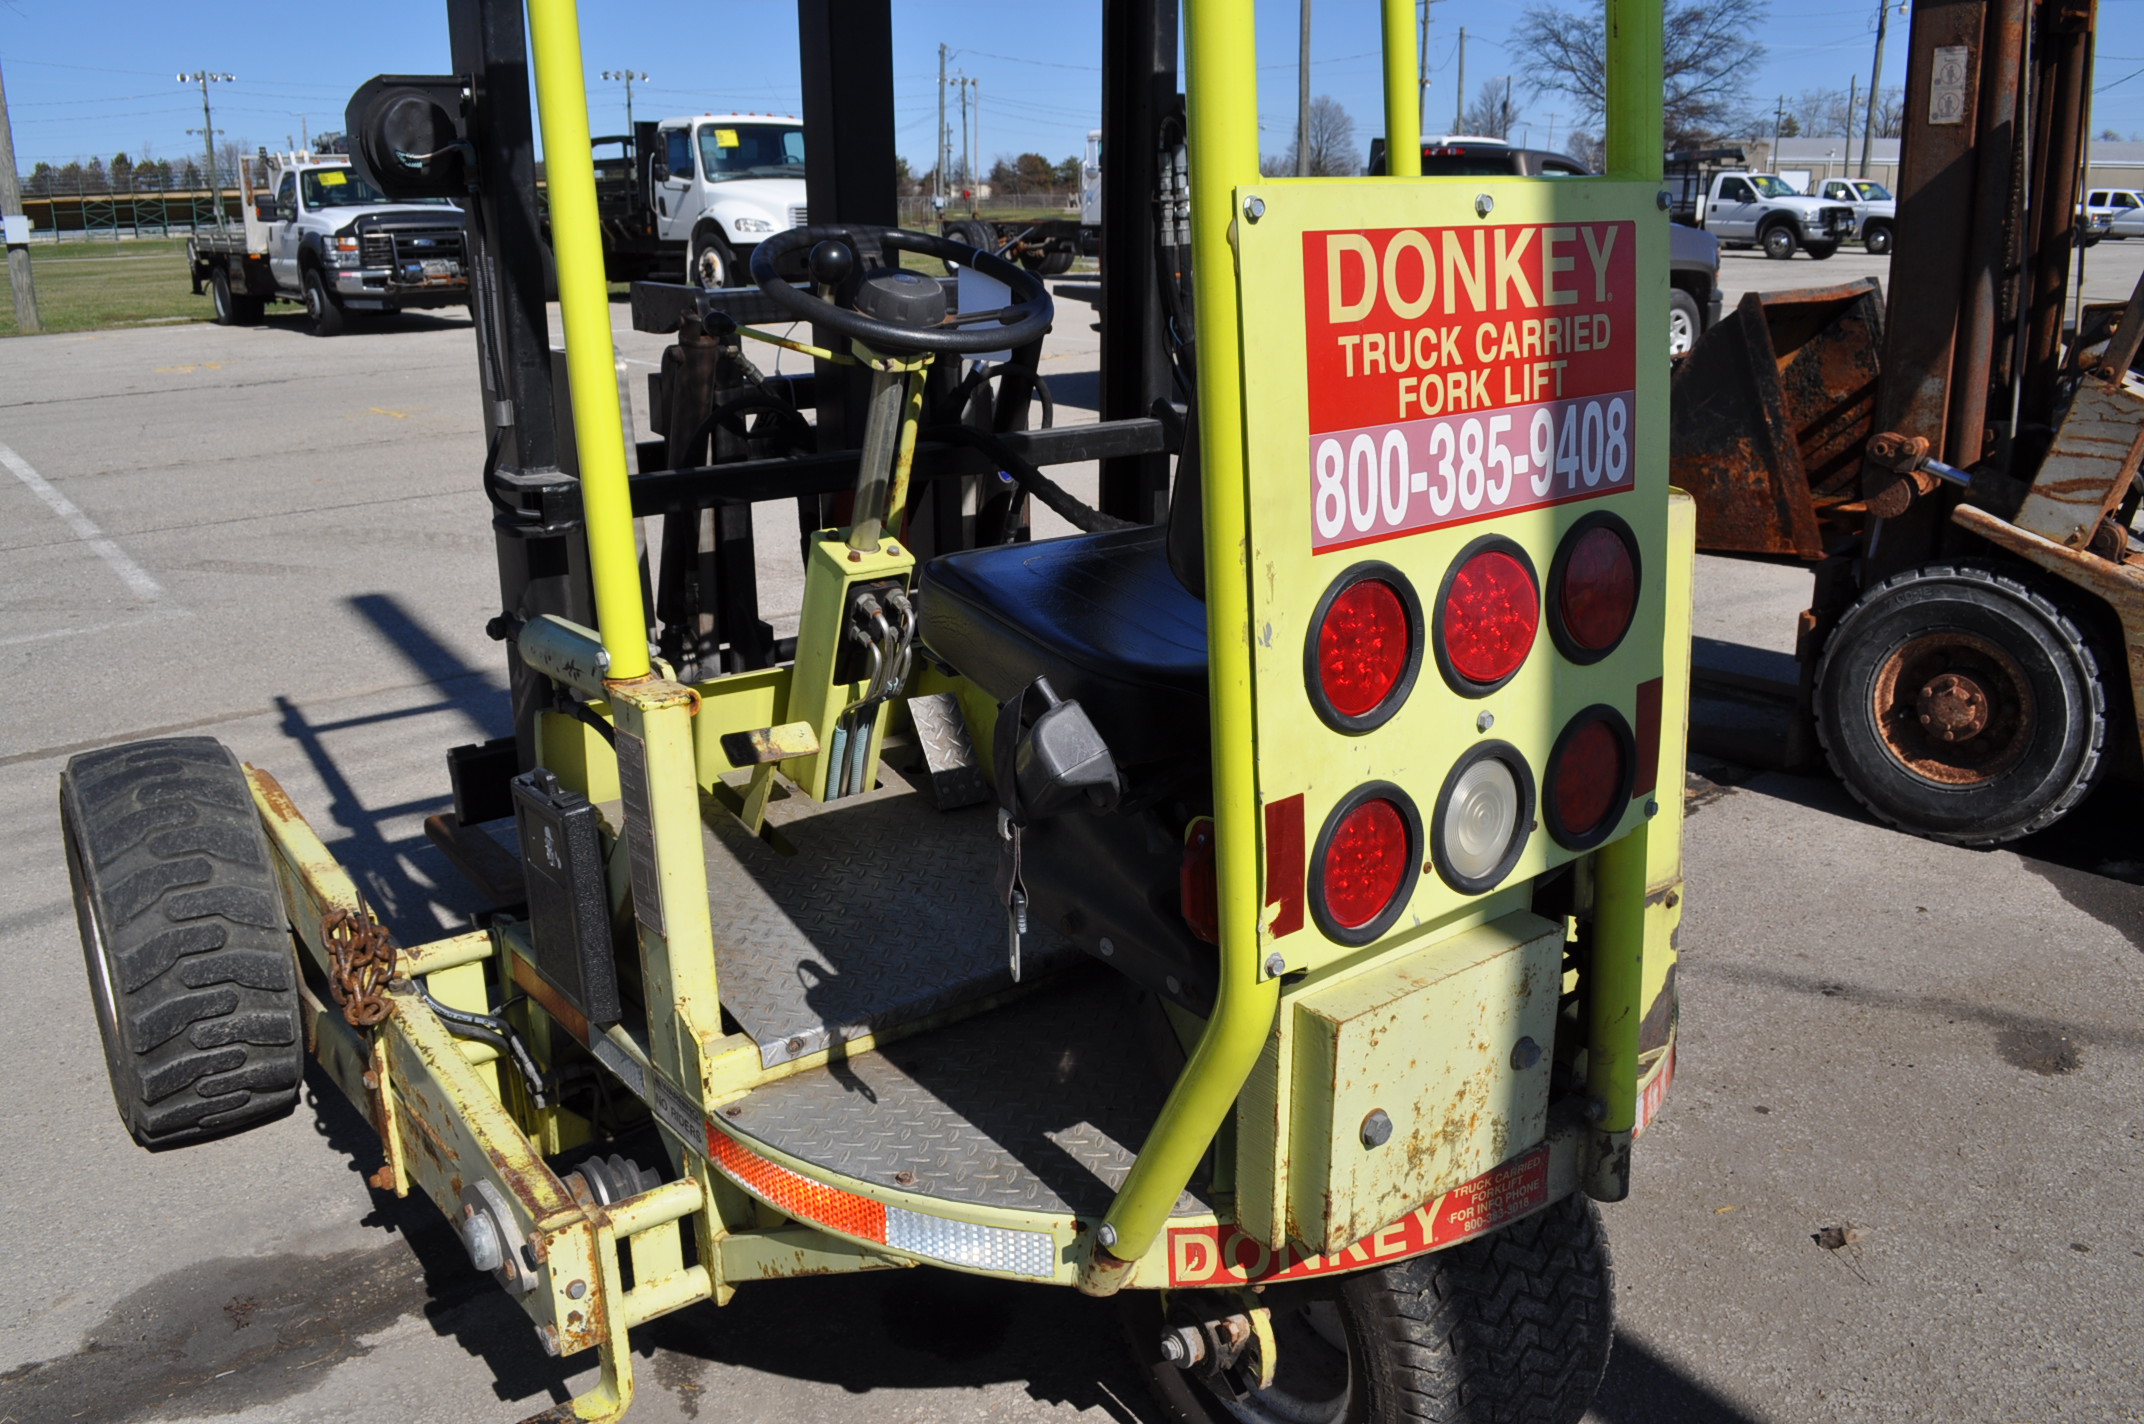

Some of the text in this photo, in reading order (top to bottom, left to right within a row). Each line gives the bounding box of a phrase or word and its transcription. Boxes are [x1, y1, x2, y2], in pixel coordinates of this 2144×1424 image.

[1326, 226, 1618, 324] DONKEY
[1338, 314, 1611, 377] TRUCK CARRIED
[1399, 360, 1568, 418] FORK LIFT
[1316, 397, 1627, 538] 800-385-9408
[655, 1092, 702, 1143] NO RIDERS
[1450, 1179, 1541, 1224] FOR INFO PHONE
[1453, 1157, 1541, 1199] TRUCK CARRIED
[1471, 1175, 1524, 1204] FORKLIFT
